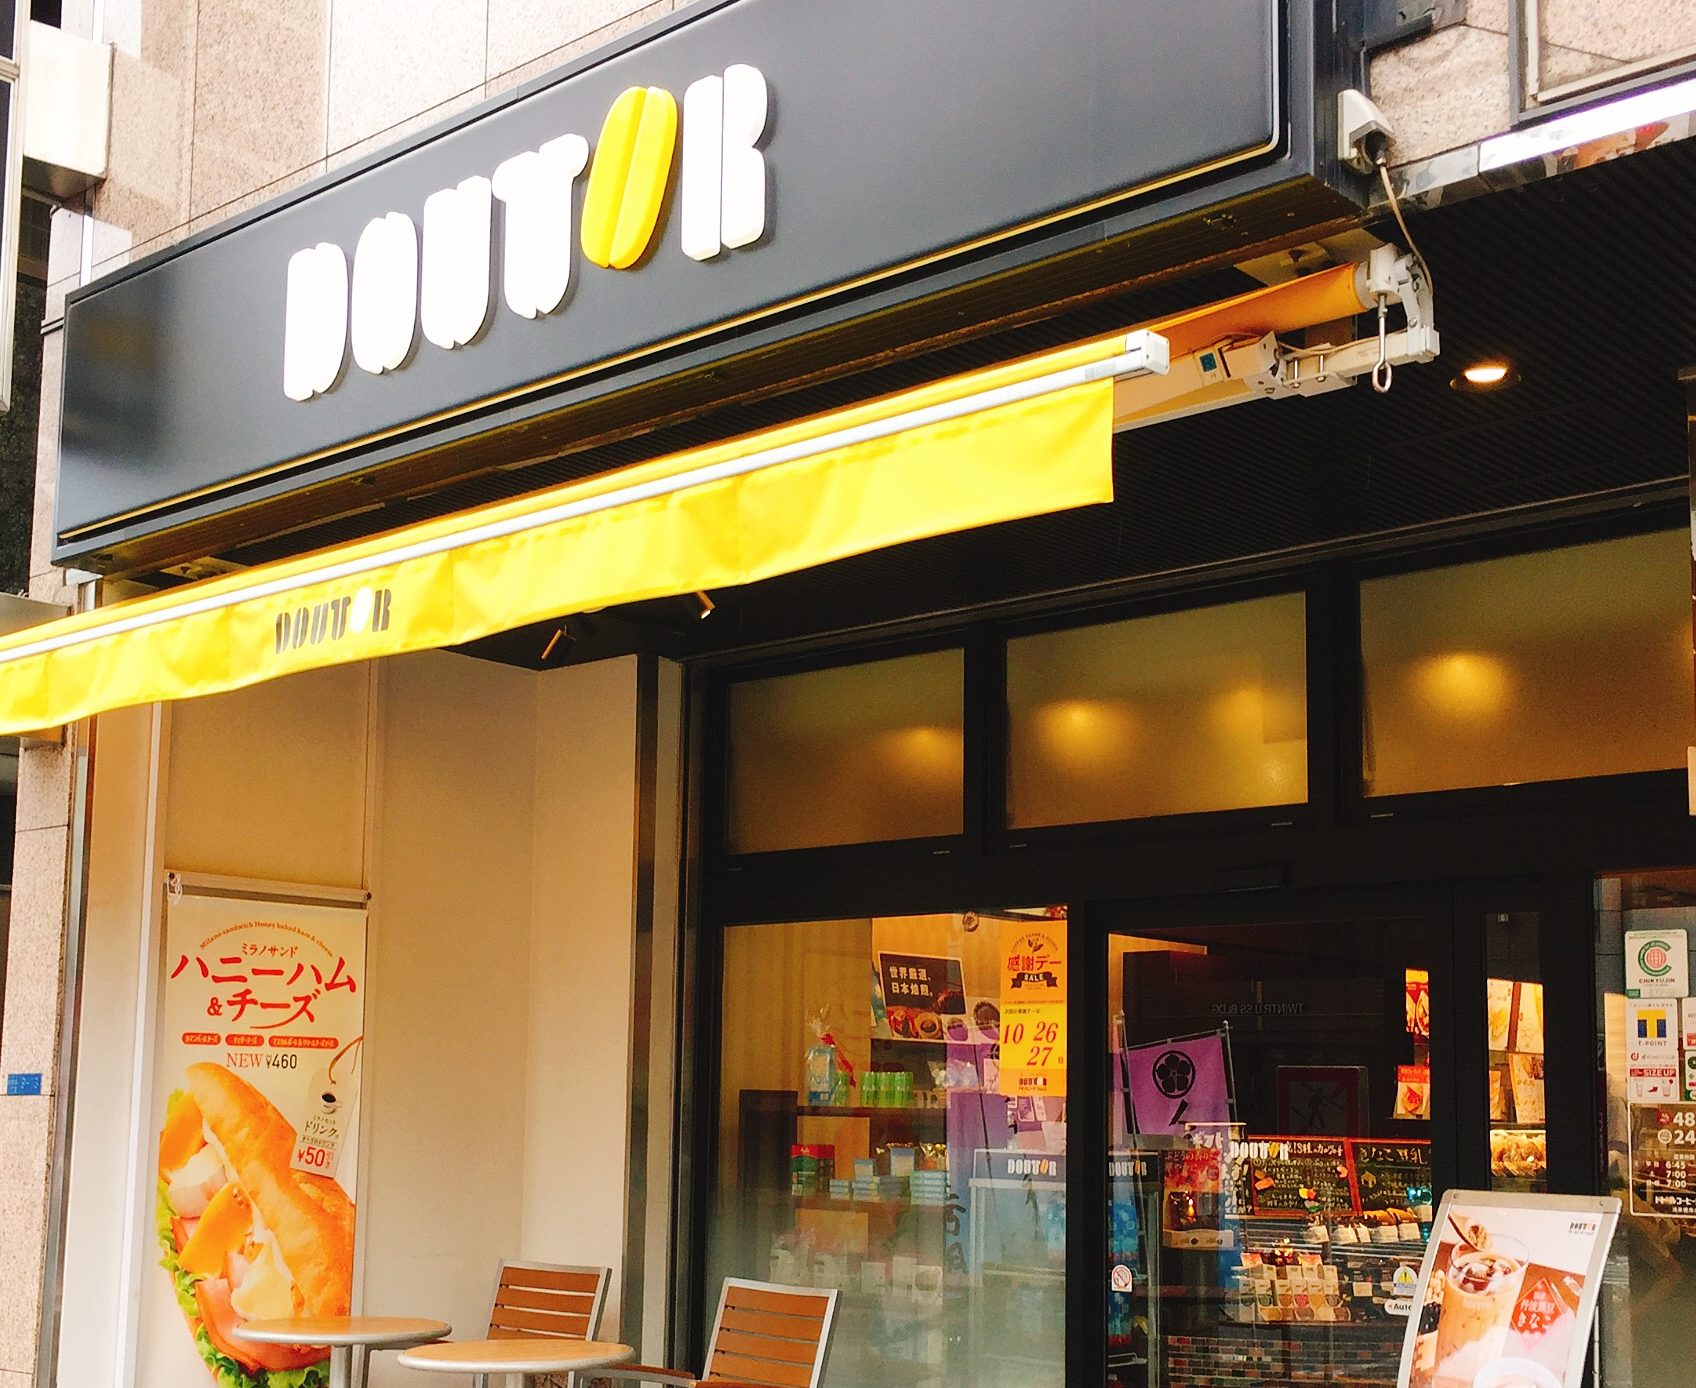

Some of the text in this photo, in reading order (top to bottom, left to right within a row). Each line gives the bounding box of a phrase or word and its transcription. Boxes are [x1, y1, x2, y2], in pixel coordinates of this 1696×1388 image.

[283, 63, 769, 402] DOUTOR
[276, 587, 391, 654] DOUTOR
[242, 943, 298, 958] ミラノサンド
[1007, 954, 1062, 972] 感謝デー
[171, 955, 356, 993] ハニーハム
[1024, 973, 1044, 982] SALE
[207, 988, 321, 1029] & チーズ
[1003, 1020, 1059, 1045] 10 26
[226, 1053, 297, 1069] NEW ¥460
[1027, 1045, 1053, 1067] 27
[1644, 1069, 1676, 1077] SIZE UP
[1673, 1112, 1695, 1127] 48
[1674, 1129, 1696, 1145] 24
[297, 1145, 325, 1167] ¥50
[1229, 1141, 1289, 1161] DOUTOR
[1007, 1158, 1056, 1177] DOUTOR
[1109, 1160, 1147, 1177] DOUTOR
[1665, 1160, 1686, 1170] 6:45
[1665, 1170, 1687, 1179] 7:00
[1665, 1179, 1687, 1189] 7:00
